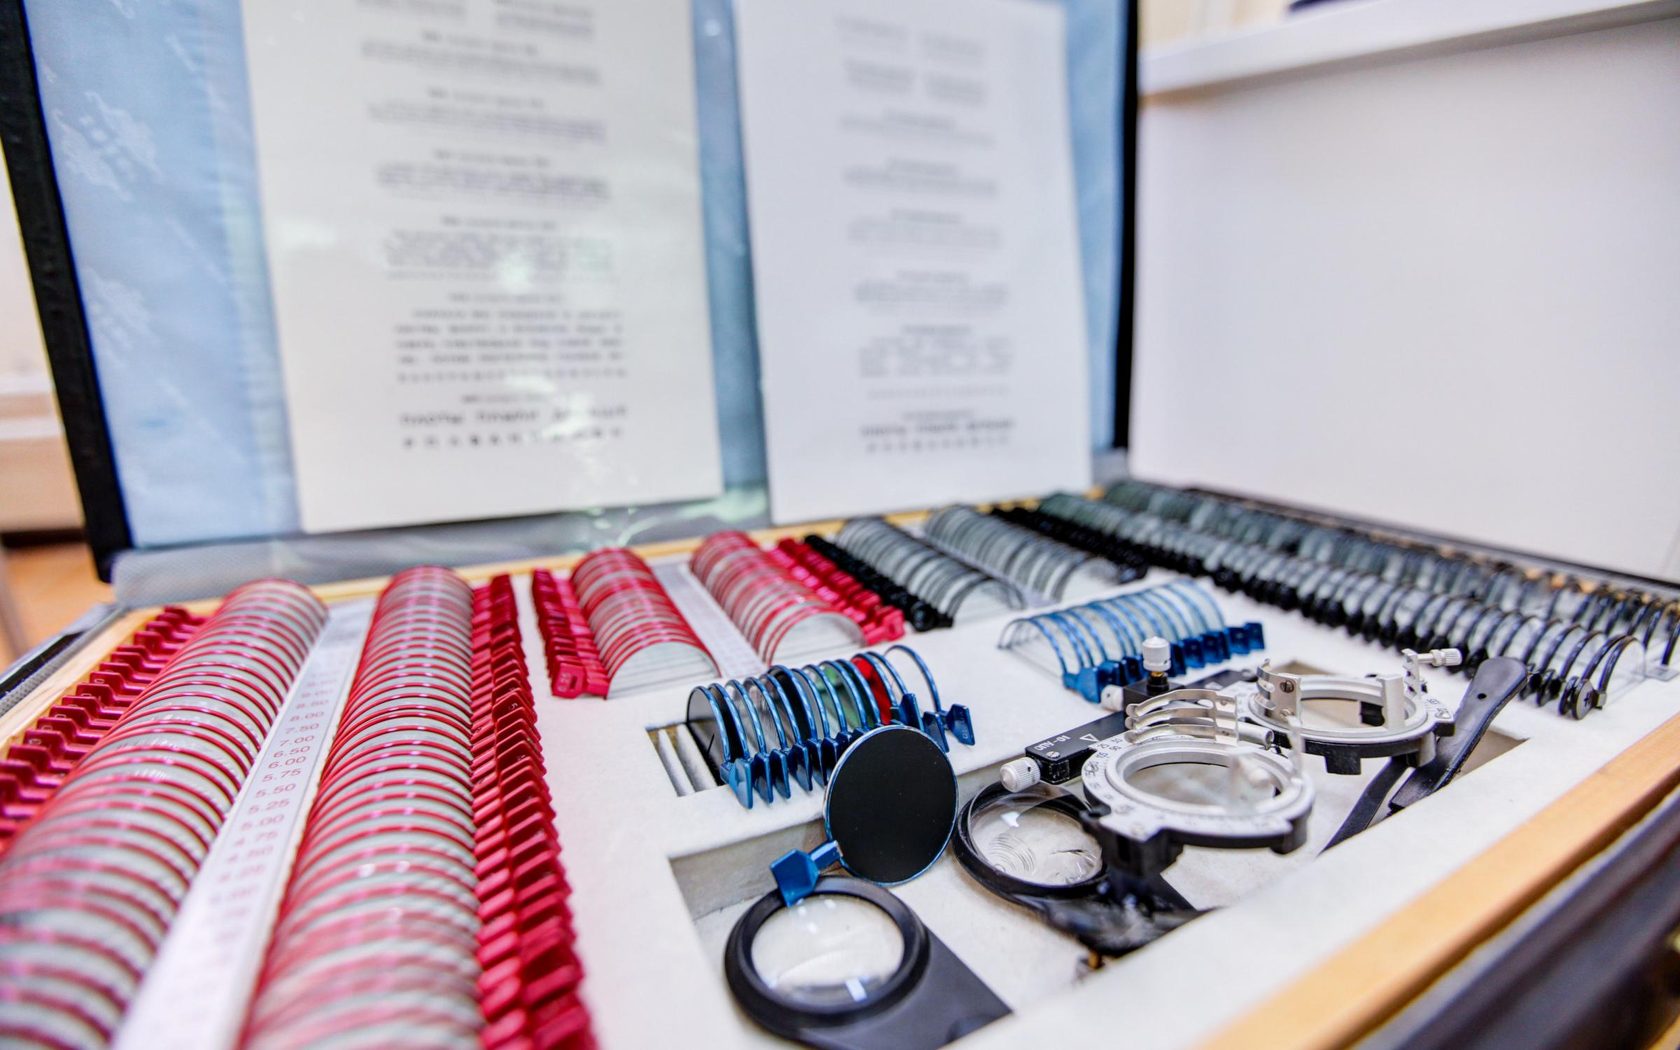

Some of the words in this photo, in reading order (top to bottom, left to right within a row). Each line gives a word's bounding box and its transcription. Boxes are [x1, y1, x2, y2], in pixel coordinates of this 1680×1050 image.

[285, 723, 320, 734] 7.50
[280, 735, 315, 747] 7.00
[273, 746, 311, 758] 6.50
[268, 756, 306, 769] 6.00
[262, 769, 302, 782] 5.75
[255, 783, 297, 798] 5.50
[249, 799, 290, 815] 5.25
